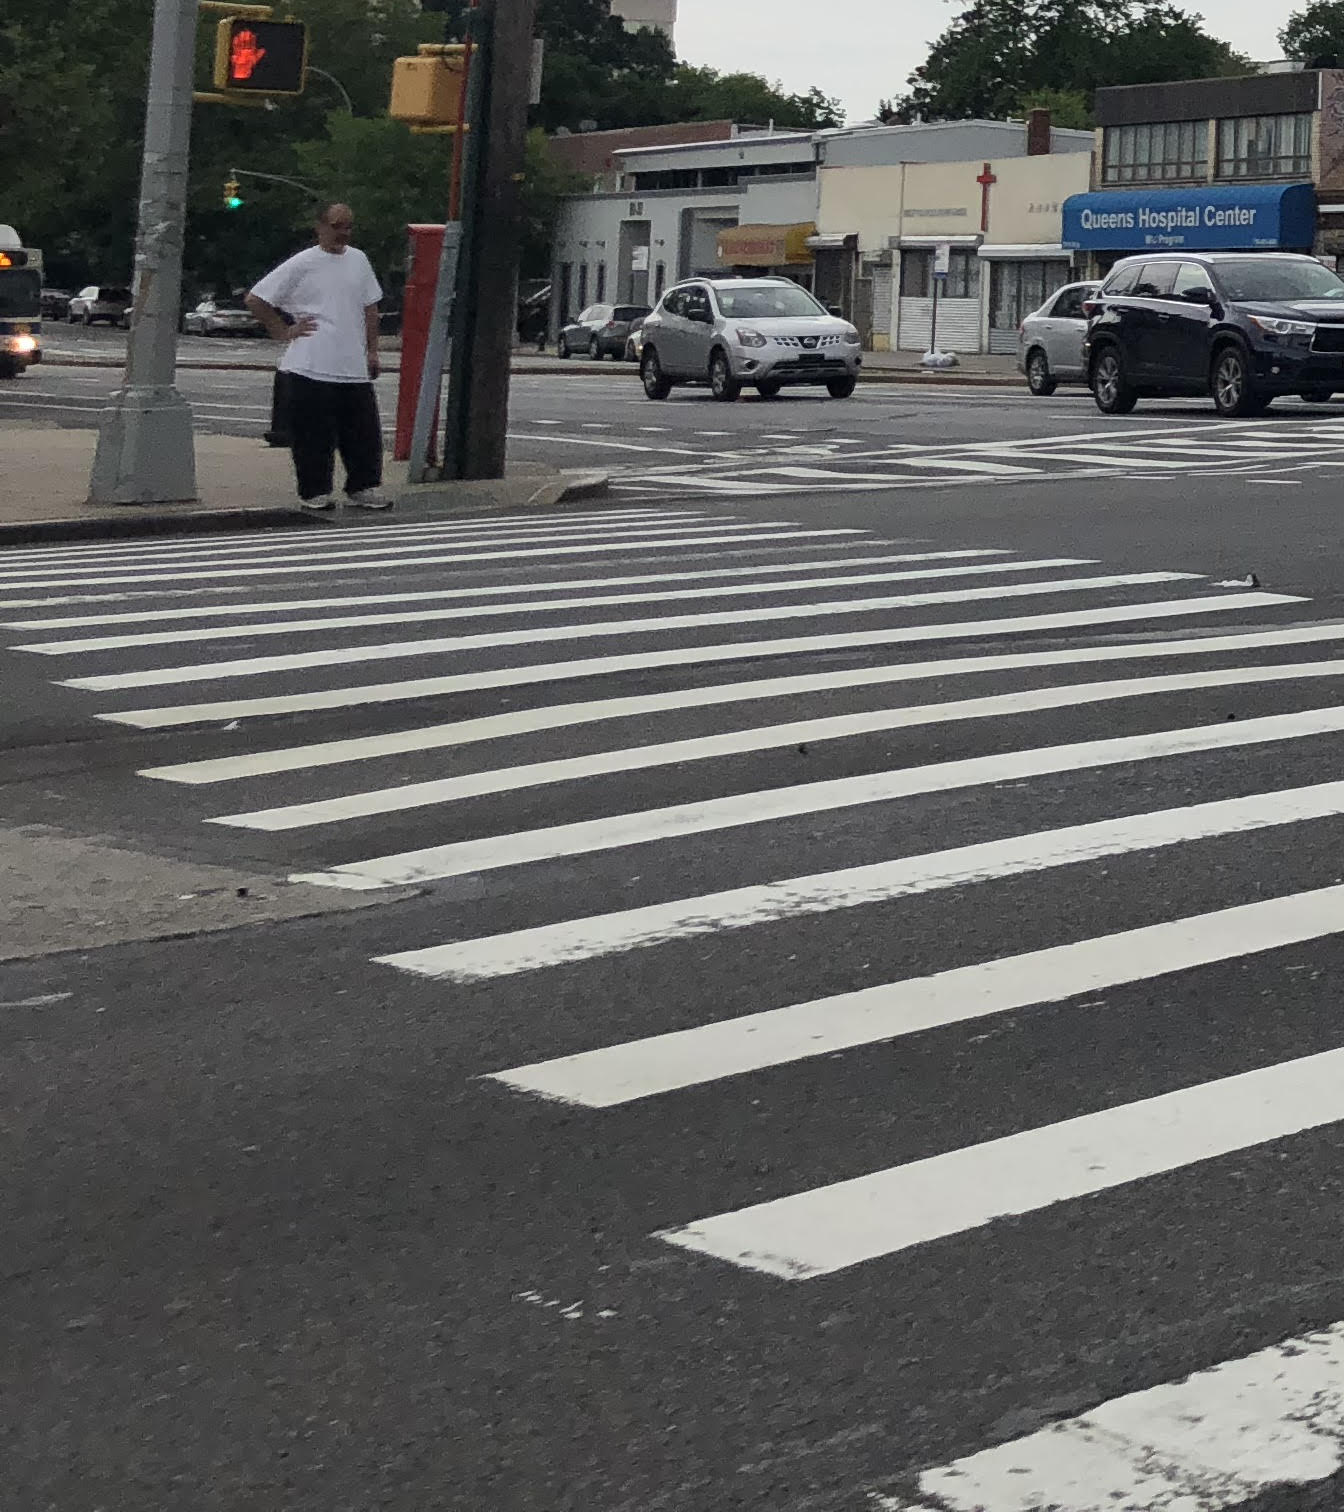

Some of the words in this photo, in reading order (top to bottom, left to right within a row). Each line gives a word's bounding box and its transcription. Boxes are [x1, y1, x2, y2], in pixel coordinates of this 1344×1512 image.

[1080, 208, 1135, 230] Queens
[1138, 206, 1200, 232] Hospital
[1203, 205, 1257, 227] Center
